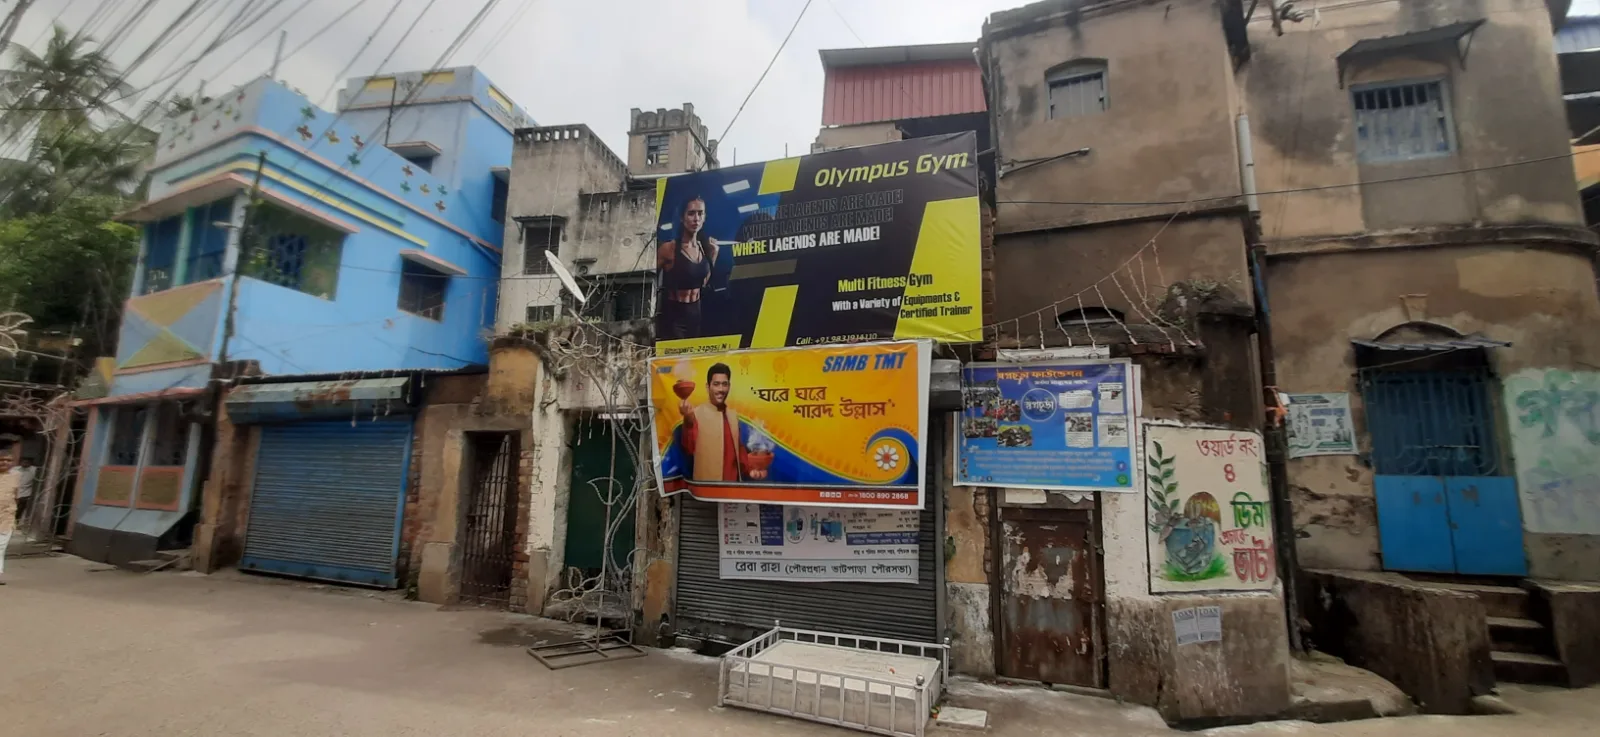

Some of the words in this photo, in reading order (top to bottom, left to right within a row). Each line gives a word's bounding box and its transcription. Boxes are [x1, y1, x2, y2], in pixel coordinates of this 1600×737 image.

[815, 160, 909, 187] Olympus
[916, 152, 968, 175] Gym
[789, 197, 837, 218] LAGENDS
[840, 193, 865, 211] ARE
[866, 188, 904, 207] MADE!
[781, 215, 828, 236] LAGENDS
[831, 211, 855, 229] ARE
[856, 207, 893, 225] MADE!
[732, 240, 767, 258] WHERE
[769, 233, 816, 253] LAGENDS
[819, 230, 841, 247] ARE
[843, 225, 880, 244] MADE!
[838, 277, 865, 292] Multi
[867, 275, 906, 290] Fitness
[909, 273, 933, 287] Gym
[832, 300, 851, 311] With
[852, 301, 858, 310] a
[859, 297, 890, 309] Variety
[892, 296, 901, 307] of
[904, 293, 952, 306] Equipments
[954, 291, 960, 302] &
[900, 307, 938, 319] Certified
[940, 305, 972, 316] Trainer
[796, 337, 813, 345] Call:
[822, 354, 869, 373] SRMB
[874, 352, 908, 370] TMT
[794, 386, 828, 401] ঘরে
[793, 403, 834, 418] শারদ
[1196, 433, 1236, 457] ওয়ার্ড
[1223, 463, 1236, 482] ৪
[735, 561, 757, 572] রেবা
[760, 561, 781, 572] রাহা
[785, 562, 827, 575] (পৌরপ্রধান
[831, 563, 867, 574] ভাটপাড়া
[871, 563, 912, 576] পৌরসভা)
